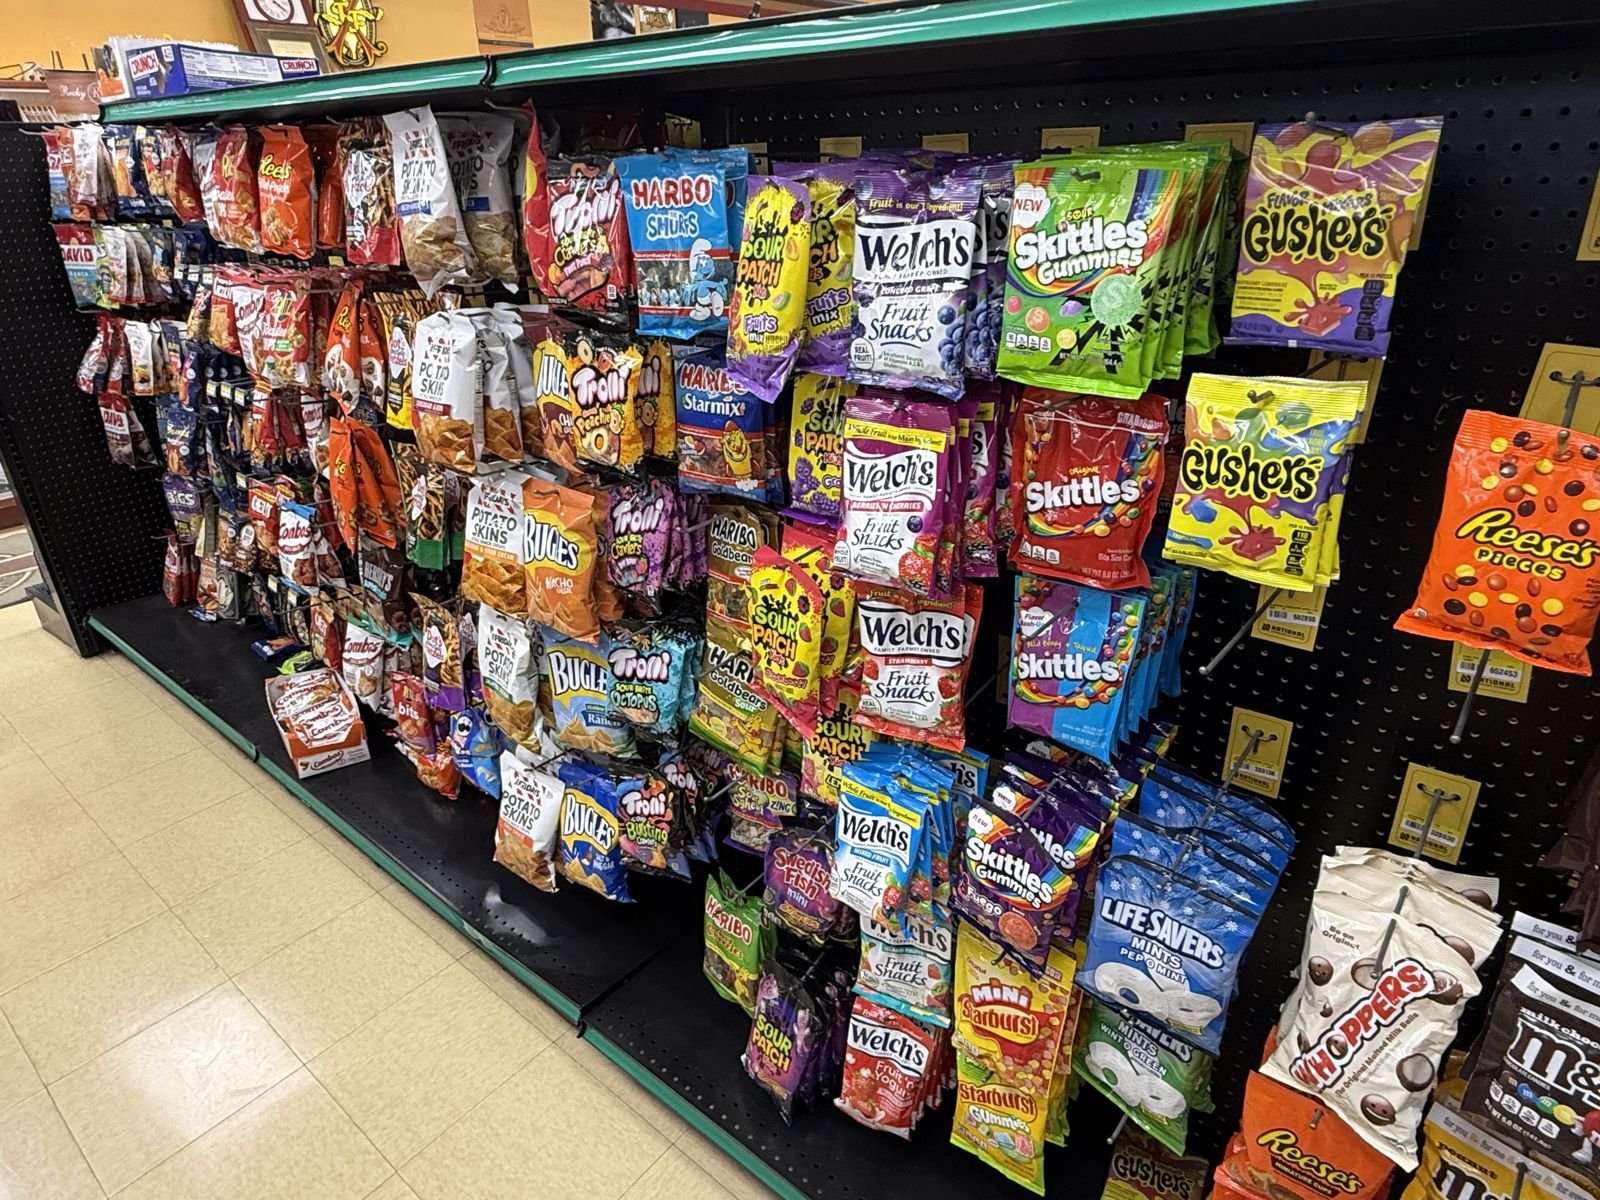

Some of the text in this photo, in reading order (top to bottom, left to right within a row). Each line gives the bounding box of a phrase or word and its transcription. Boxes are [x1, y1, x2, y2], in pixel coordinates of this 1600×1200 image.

[131, 51, 158, 78] CRUNCH
[282, 60, 315, 74] CRUNCH
[869, 199, 893, 212] Fruit
[1014, 197, 1043, 213] NEW
[1066, 207, 1094, 222] SOUR
[1266, 191, 1309, 209] FLAVOR
[646, 212, 699, 240] SMURFS
[61, 248, 93, 262] DAVID
[743, 235, 784, 259] SOUR
[858, 227, 970, 273] Welch's
[1015, 216, 1149, 271] Skittles
[739, 260, 781, 287] PATCH
[1037, 248, 1144, 286] Gummies
[744, 315, 777, 333] Fruits
[812, 312, 839, 325] mix
[881, 303, 931, 323] Fruit
[748, 333, 764, 343] mix
[854, 345, 870, 354] REAL
[572, 362, 632, 406] Trolli
[685, 393, 742, 417] Starmix
[846, 453, 934, 495] Welch's
[1026, 476, 1141, 513] Skittles
[472, 507, 518, 532] POTATO
[612, 498, 665, 534] Trolli
[862, 517, 900, 534] Fruit
[472, 523, 508, 545] SKINS
[711, 516, 758, 551] HARIBO
[1455, 508, 1600, 566] Reese's
[545, 577, 574, 591] NACHO
[754, 605, 798, 640] SOUR
[860, 614, 961, 651] Welch's
[1024, 613, 1046, 623] Flavor
[1270, 625, 1306, 639] NATIONAL
[752, 623, 798, 660] PATCH
[549, 651, 608, 695] BUGLE
[607, 648, 672, 682] Trolli
[887, 669, 931, 689] Fruit
[1017, 652, 1122, 683] Skittles
[610, 690, 657, 712] OCTOPUS
[710, 670, 768, 712] Goldbears
[874, 682, 937, 704] Snacks
[398, 704, 419, 719] bits
[313, 752, 342, 769] Combos
[810, 735, 864, 762] PATCH
[502, 790, 541, 820] POTATO
[502, 804, 534, 831] SKINS
[621, 791, 667, 816] Trolli
[562, 793, 615, 850] BUGLES
[841, 806, 909, 852] Welch's
[773, 847, 832, 893] Swedish
[783, 866, 819, 900] Fish
[840, 867, 884, 898] Snacks
[850, 860, 883, 883] Fruit
[966, 836, 1054, 905] Skittles
[786, 887, 809, 908] mini
[966, 885, 1003, 917] Fuego
[975, 864, 1041, 909] Gummies
[706, 895, 754, 945] HARIBO
[1532, 924, 1577, 945] for you &
[1342, 932, 1355, 942] an
[884, 955, 922, 974] Fruit
[1120, 947, 1145, 962] PEP
[1157, 962, 1189, 984] MINT
[1130, 935, 1183, 970] MINTS
[1532, 949, 1593, 983] for you & for
[874, 963, 928, 987] Snacks
[971, 984, 1030, 1010] MINI
[1527, 980, 1589, 1016] for you & for
[962, 999, 1038, 1037] Starburst
[1294, 963, 1428, 1088] WHOPPERS
[1520, 1005, 1561, 1031] milk
[752, 1027, 791, 1072] PATCH
[756, 1013, 792, 1056] SOUR
[851, 1022, 925, 1067] Welch's
[1117, 1020, 1159, 1058] MINTS
[1100, 1022, 1125, 1044] WINT
[1132, 1046, 1168, 1078] GREEN
[1344, 1056, 1368, 1086] Original
[1366, 1038, 1389, 1067] Malted
[1387, 1023, 1403, 1044] Milk
[876, 1060, 904, 1082] Fruit
[959, 1082, 1035, 1116] Starburst
[1257, 1128, 1364, 1195] Reese's
[1274, 1160, 1334, 1196] MINIATURE CUPS
